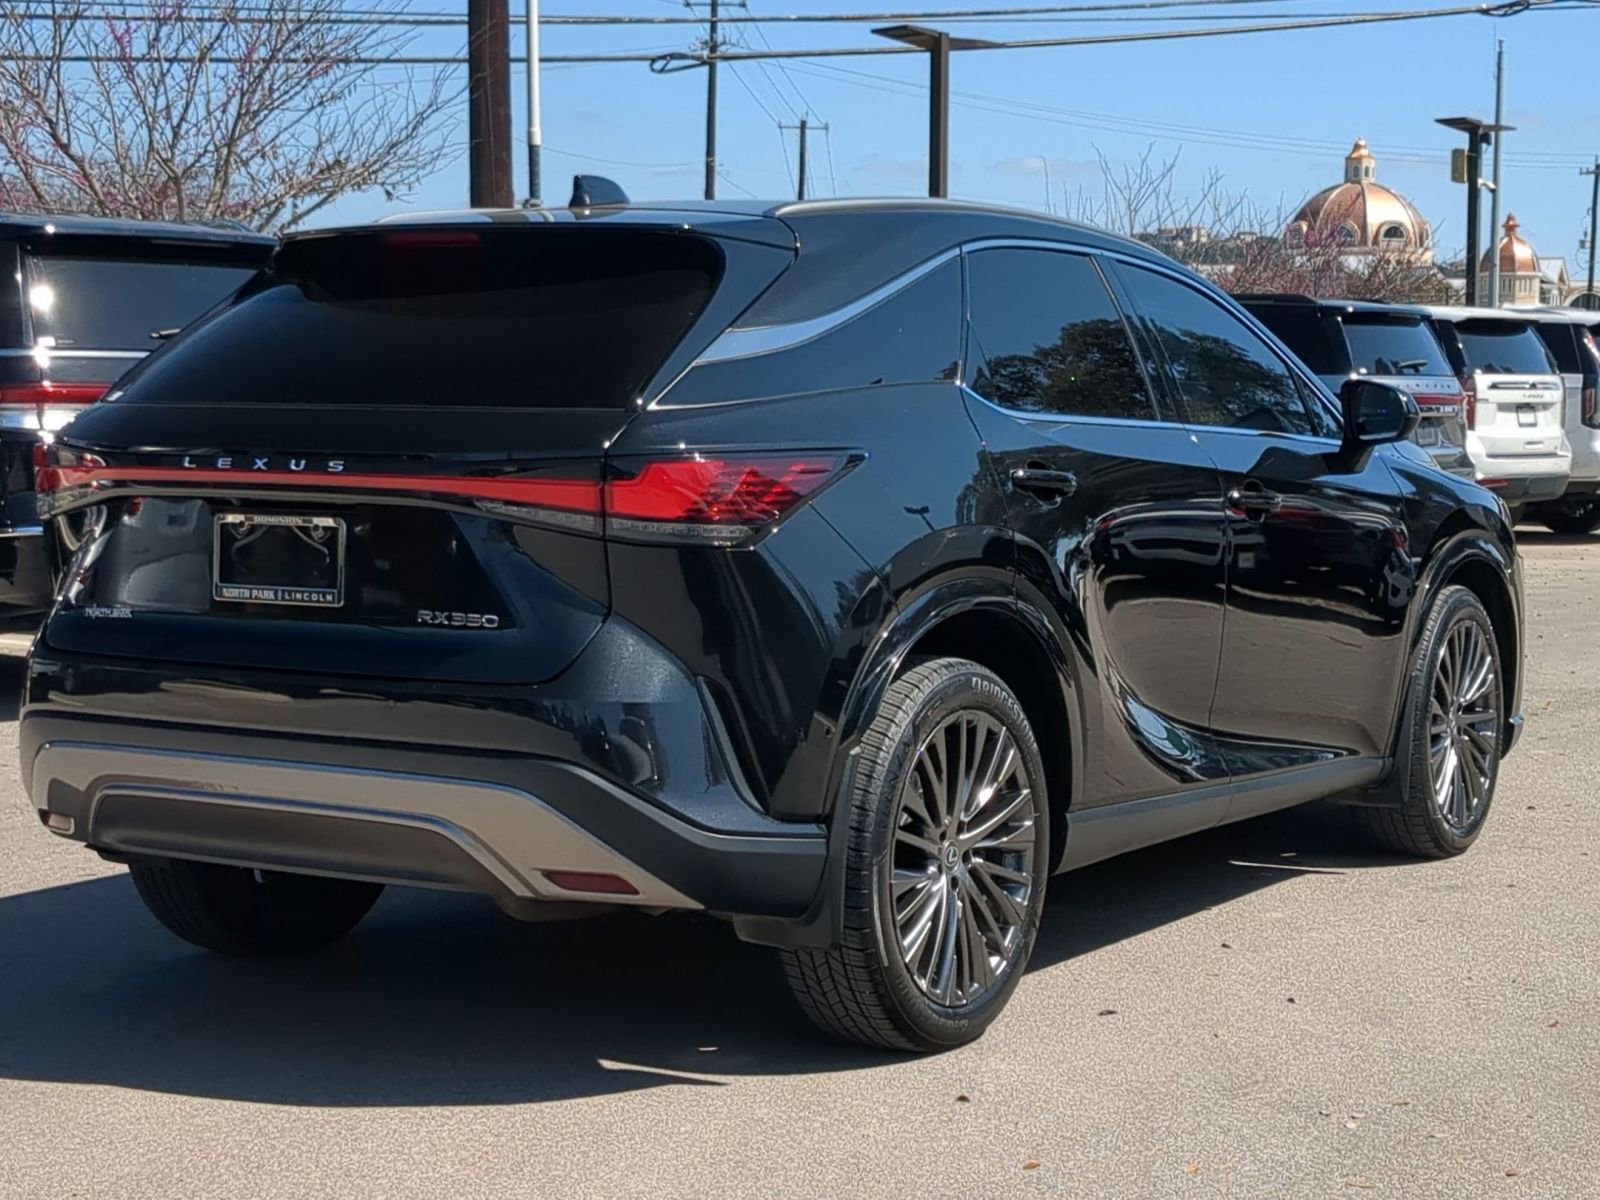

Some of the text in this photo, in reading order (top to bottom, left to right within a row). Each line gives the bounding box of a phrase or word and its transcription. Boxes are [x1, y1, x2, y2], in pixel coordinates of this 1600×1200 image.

[181, 456, 345, 472] LEXUS
[222, 587, 333, 602] NORTH PARK LINCOLN
